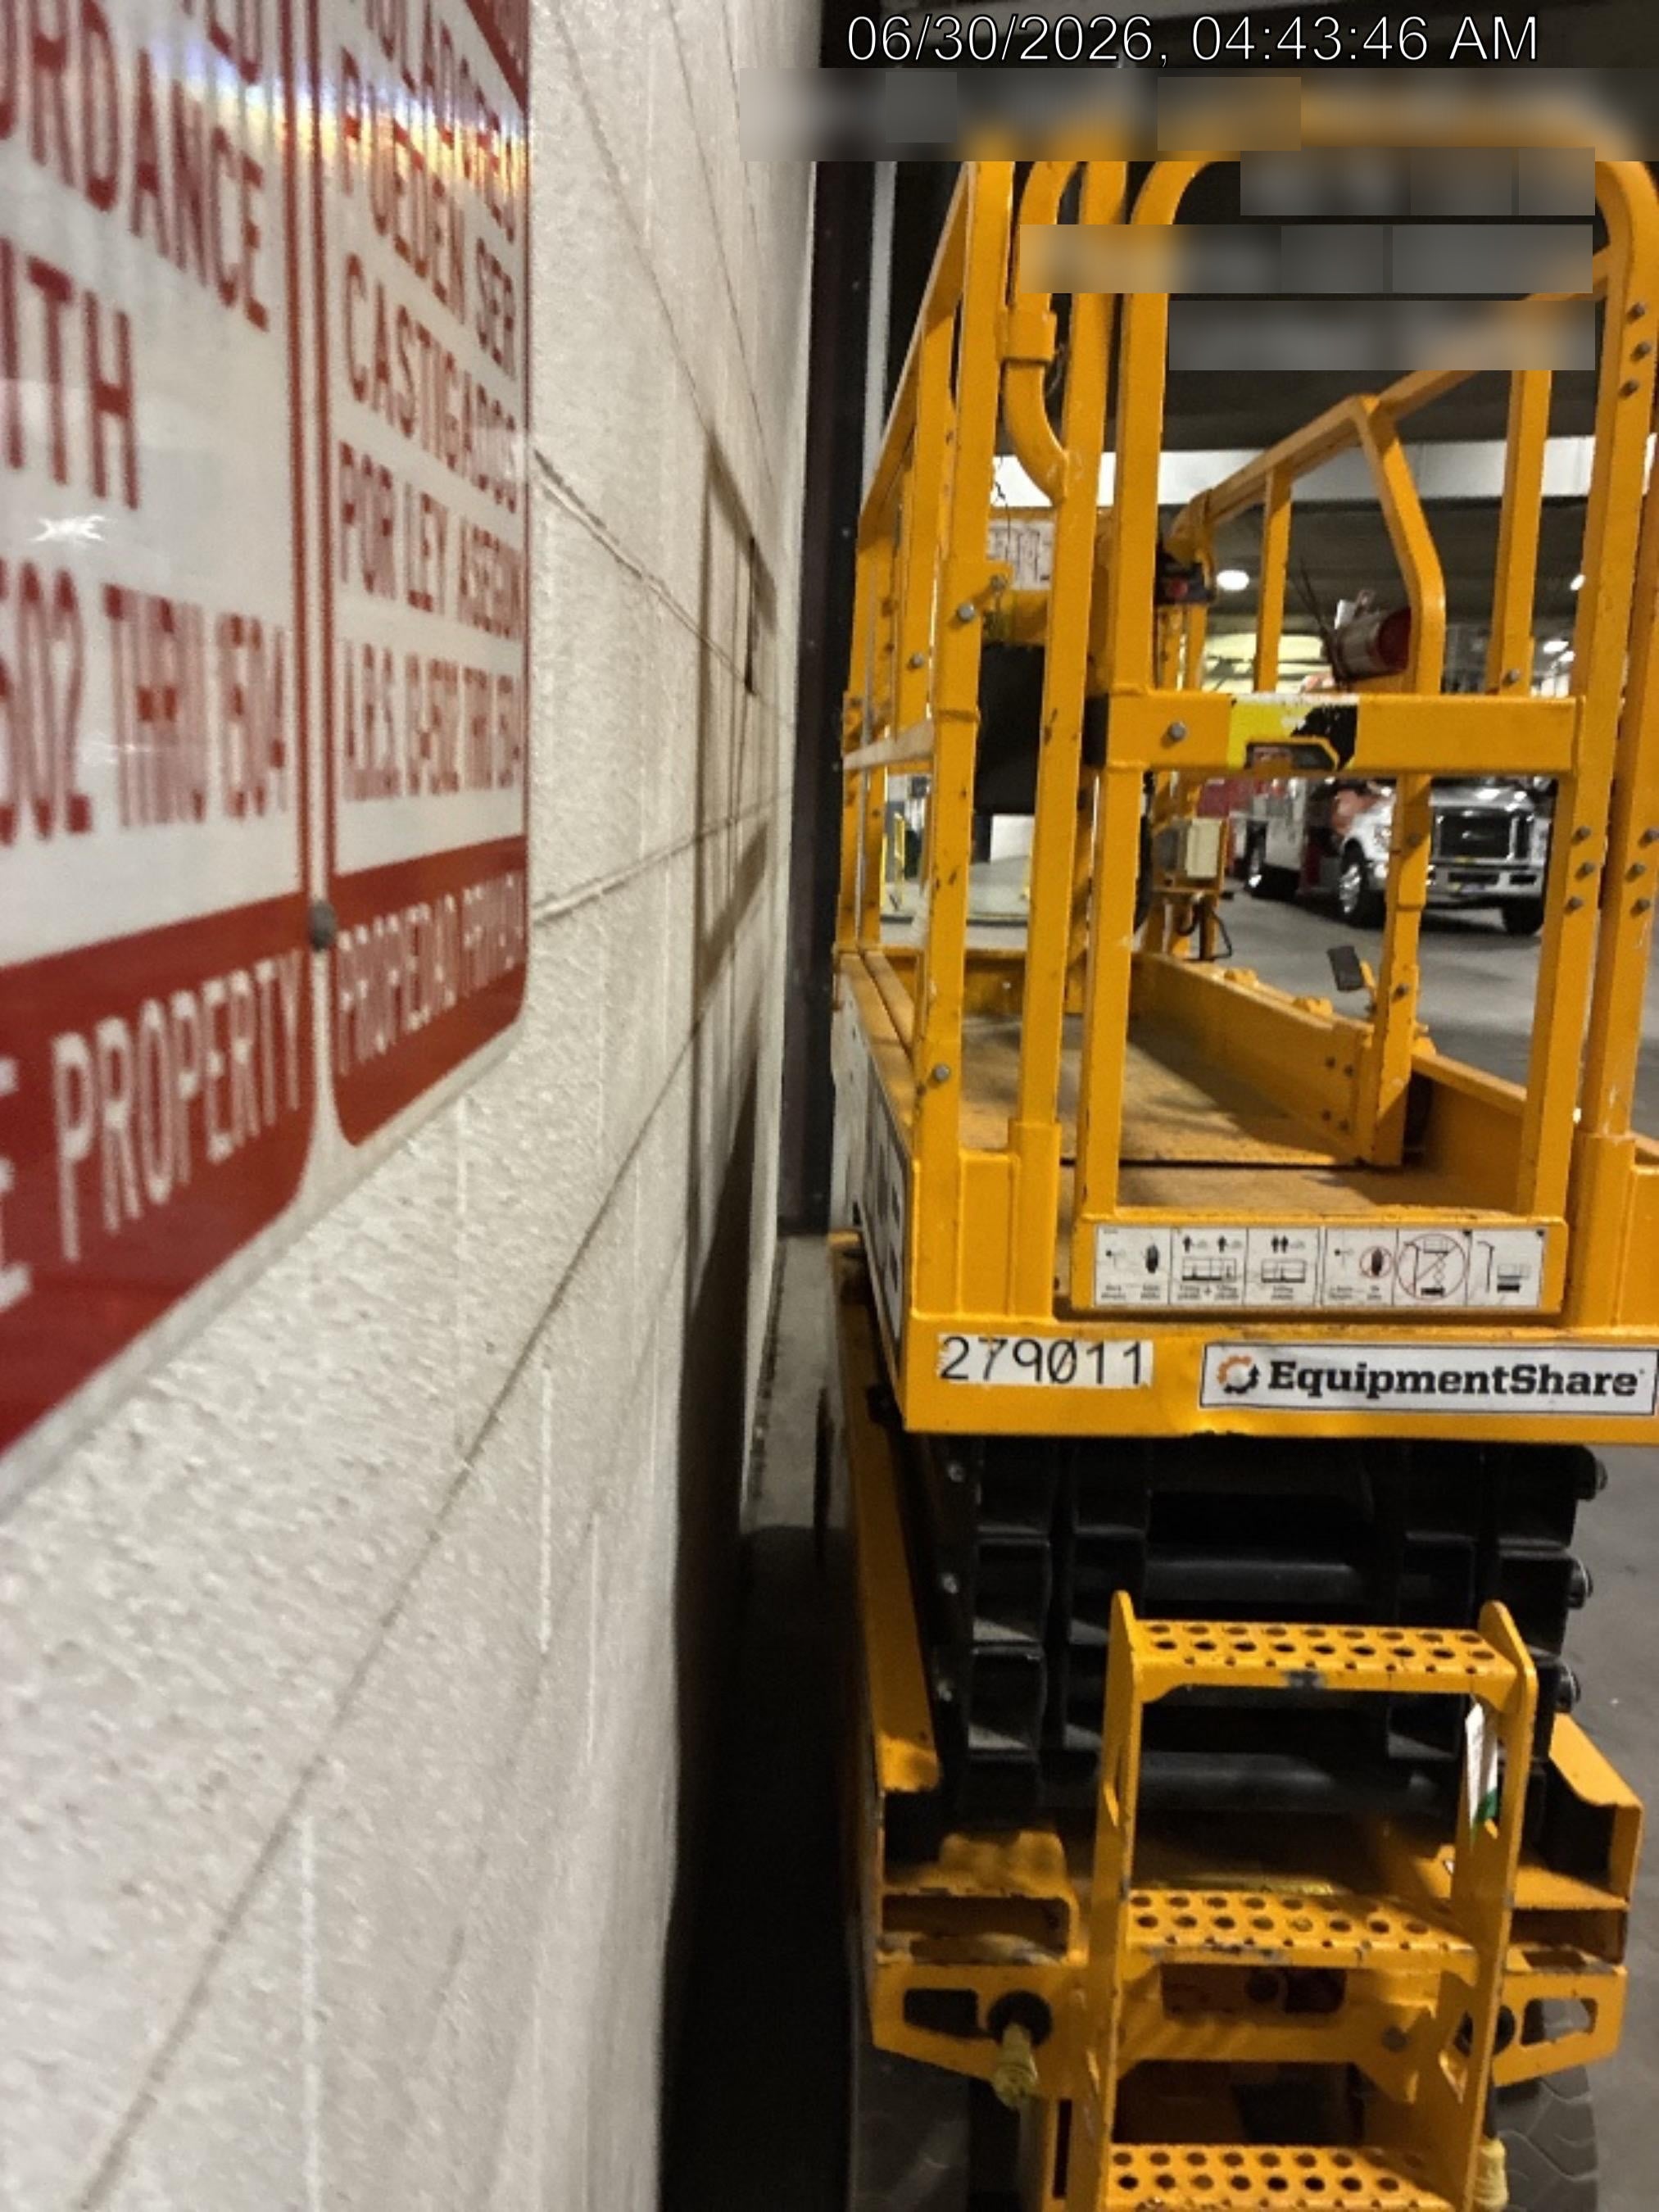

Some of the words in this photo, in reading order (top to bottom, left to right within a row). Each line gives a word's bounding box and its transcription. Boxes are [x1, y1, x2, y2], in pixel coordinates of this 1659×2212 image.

[477, 236, 516, 379] SER
[340, 440, 396, 601] POR
[404, 482, 447, 615] LEY
[51, 950, 302, 1264] PROPERTY
[940, 1335, 1142, 1385] 279011
[1269, 1360, 1639, 1398] EquipmentShare
